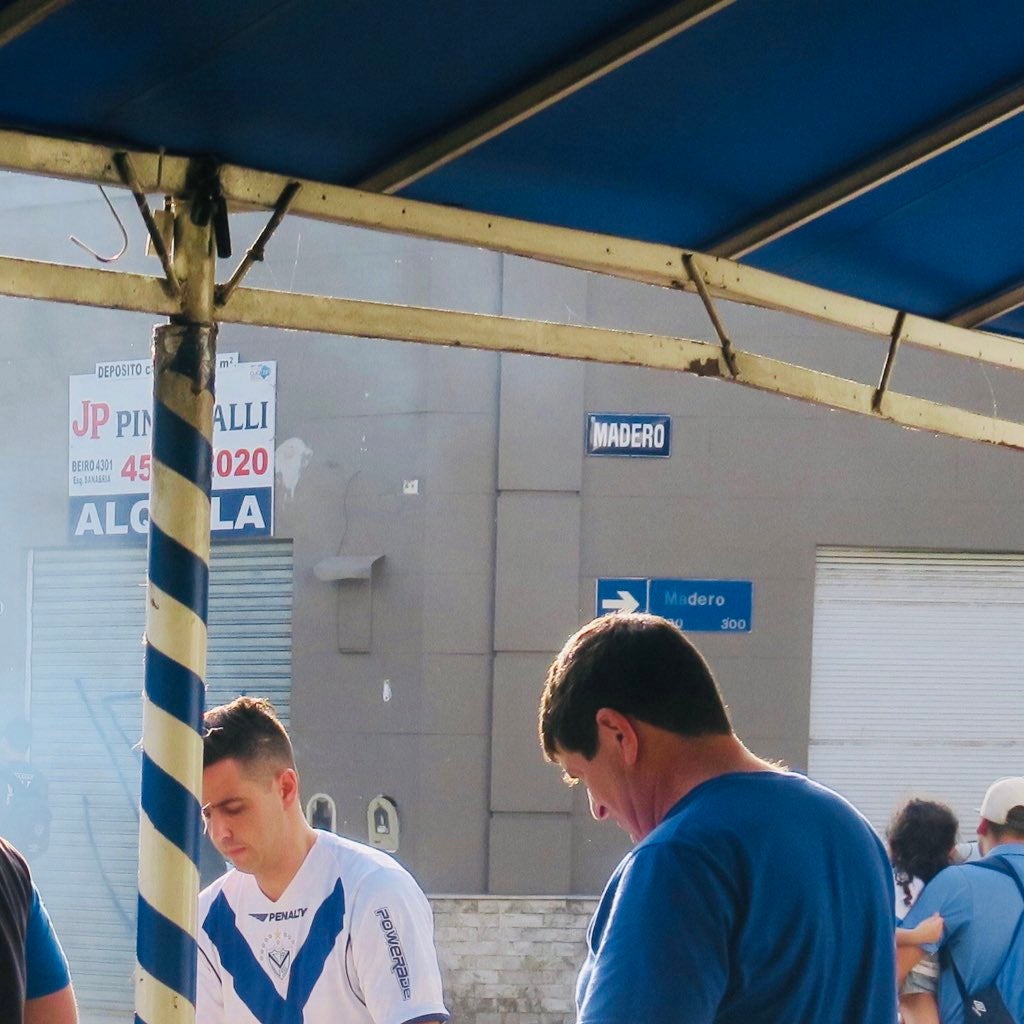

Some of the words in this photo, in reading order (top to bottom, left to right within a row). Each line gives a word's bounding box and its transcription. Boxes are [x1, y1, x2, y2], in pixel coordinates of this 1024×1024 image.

[98, 363, 143, 378] DEPOSITO
[72, 400, 111, 440] JP
[592, 422, 665, 449] MADERO
[664, 591, 726, 607] Madero
[720, 616, 747, 630] 300
[268, 907, 309, 923] PENALTY
